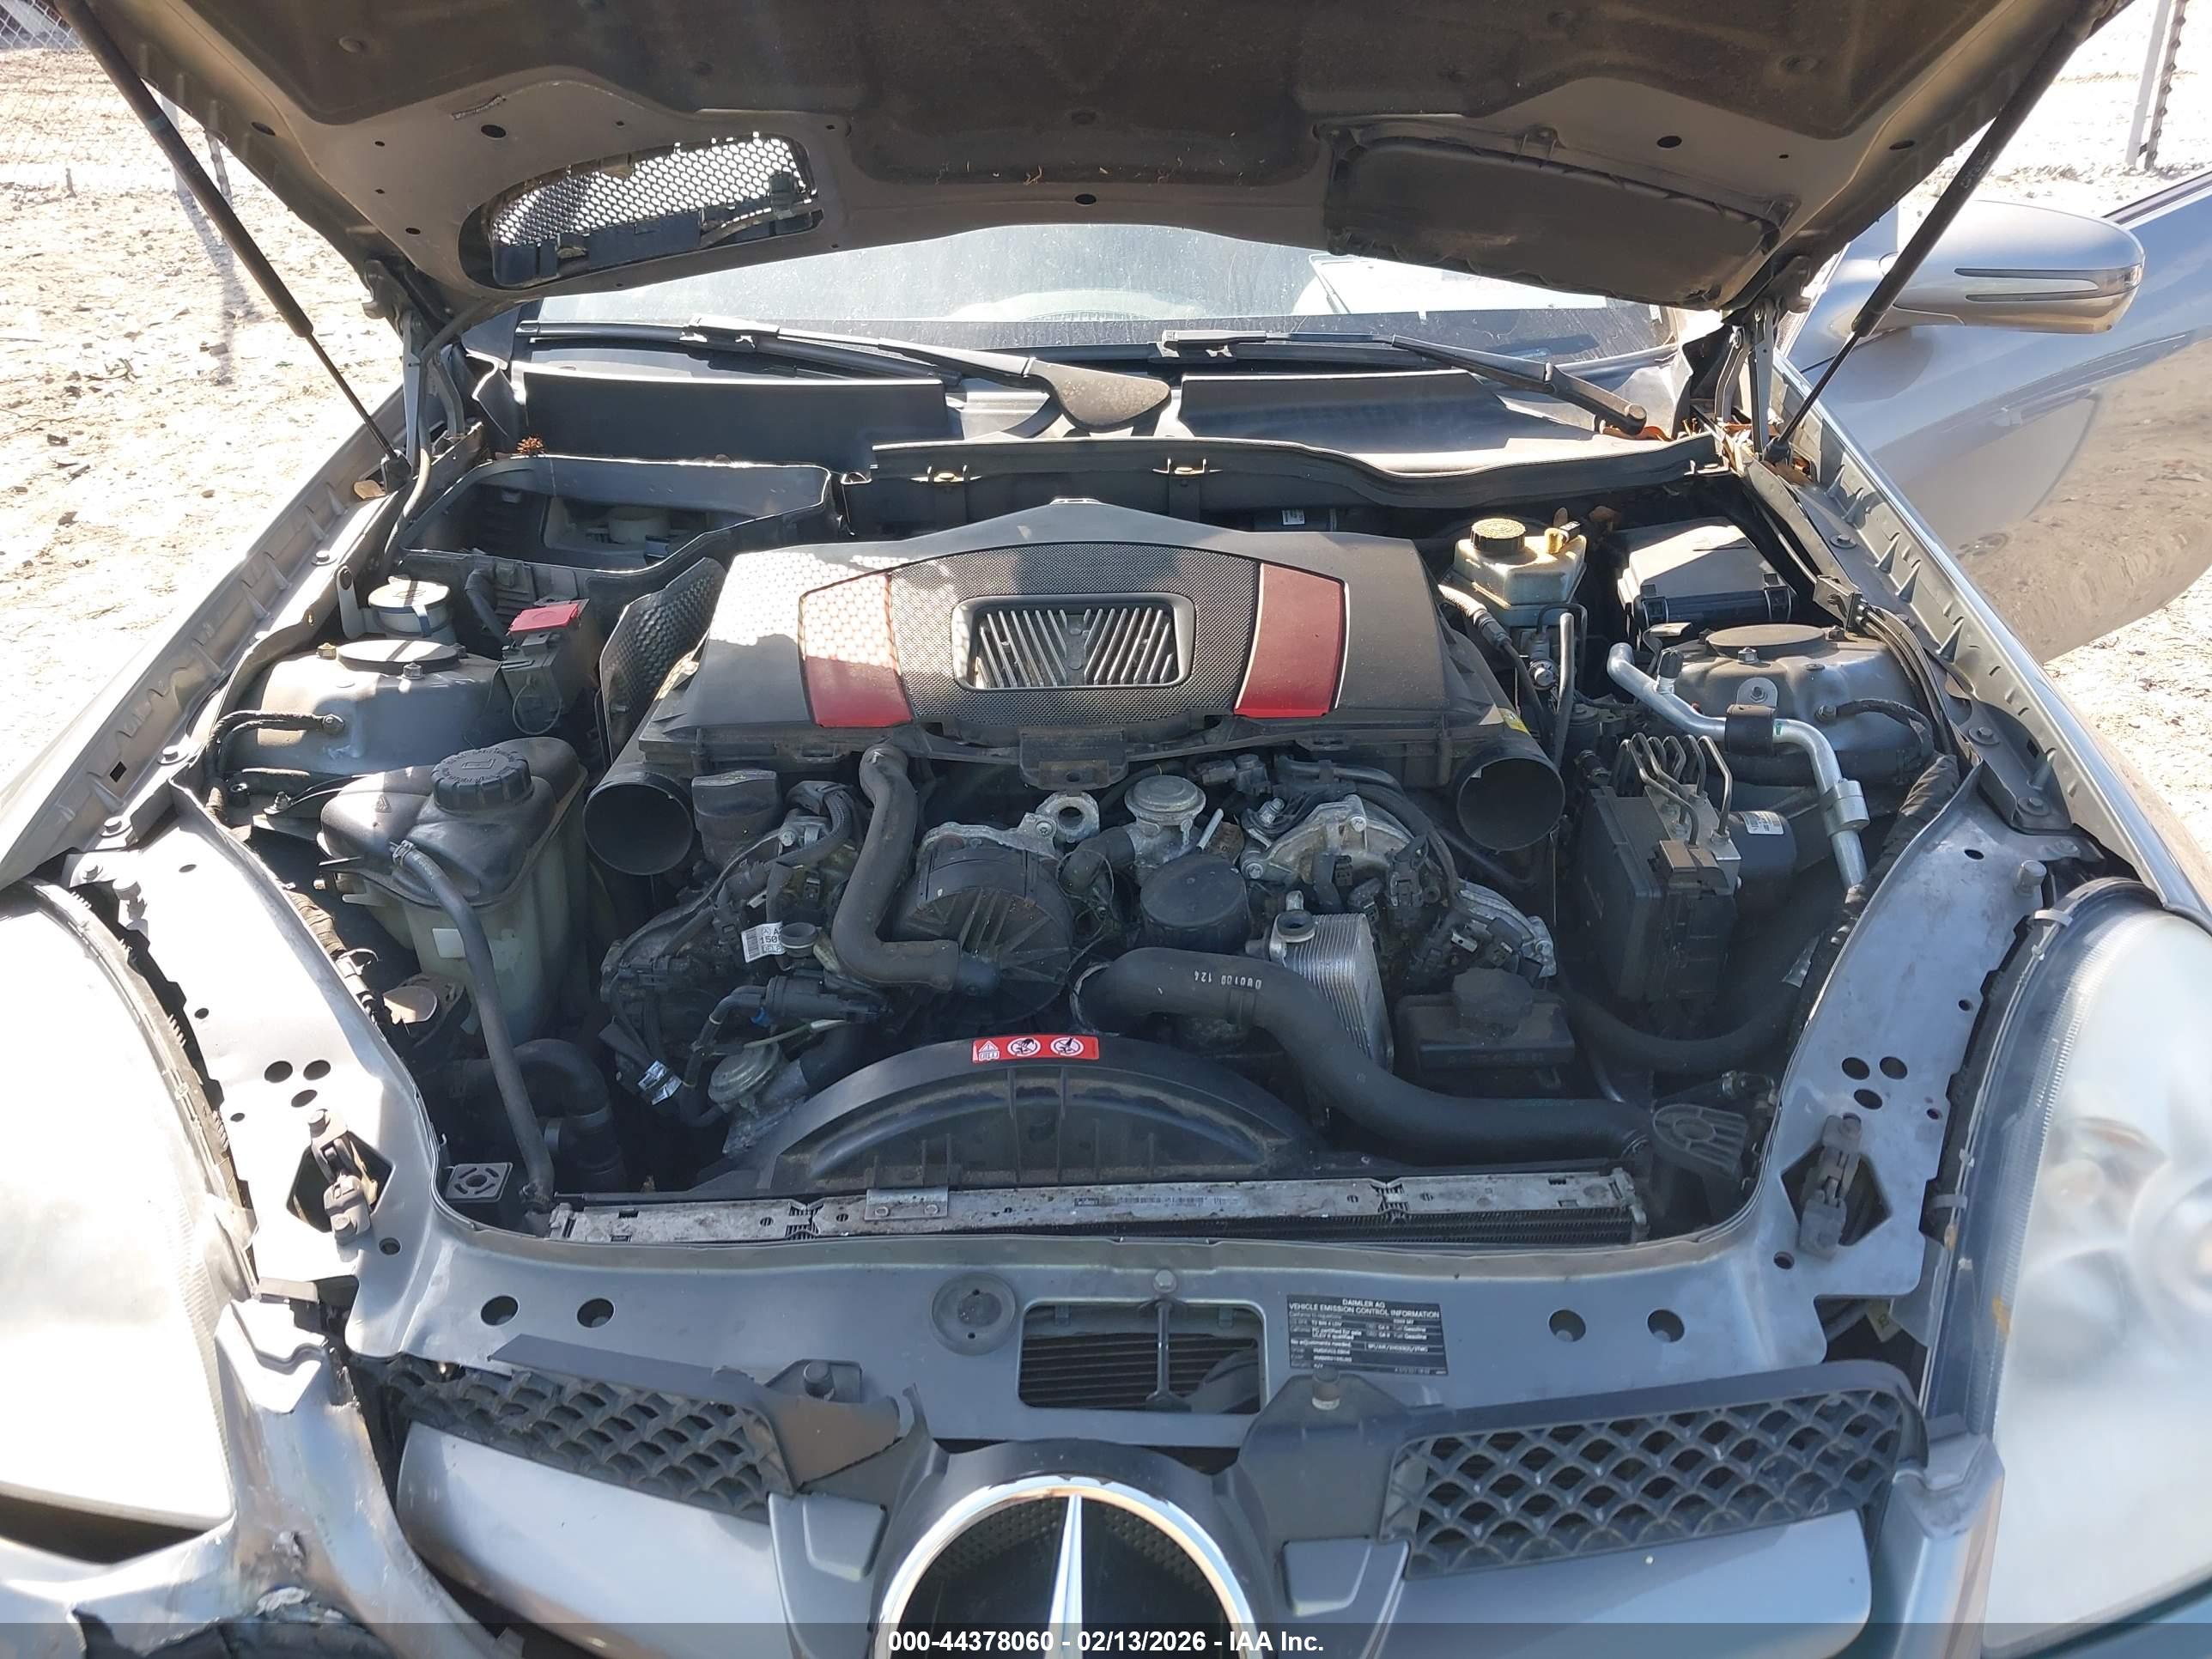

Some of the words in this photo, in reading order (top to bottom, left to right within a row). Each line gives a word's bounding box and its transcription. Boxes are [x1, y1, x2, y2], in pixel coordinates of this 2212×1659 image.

[1342, 1297, 1374, 1308] DAIMLER
[1289, 1302, 1319, 1311] VEHICLE
[1320, 1304, 1355, 1314] EMISSION
[1355, 1306, 1389, 1316] CONTROL
[1390, 1309, 1440, 1318] INFORMATION
